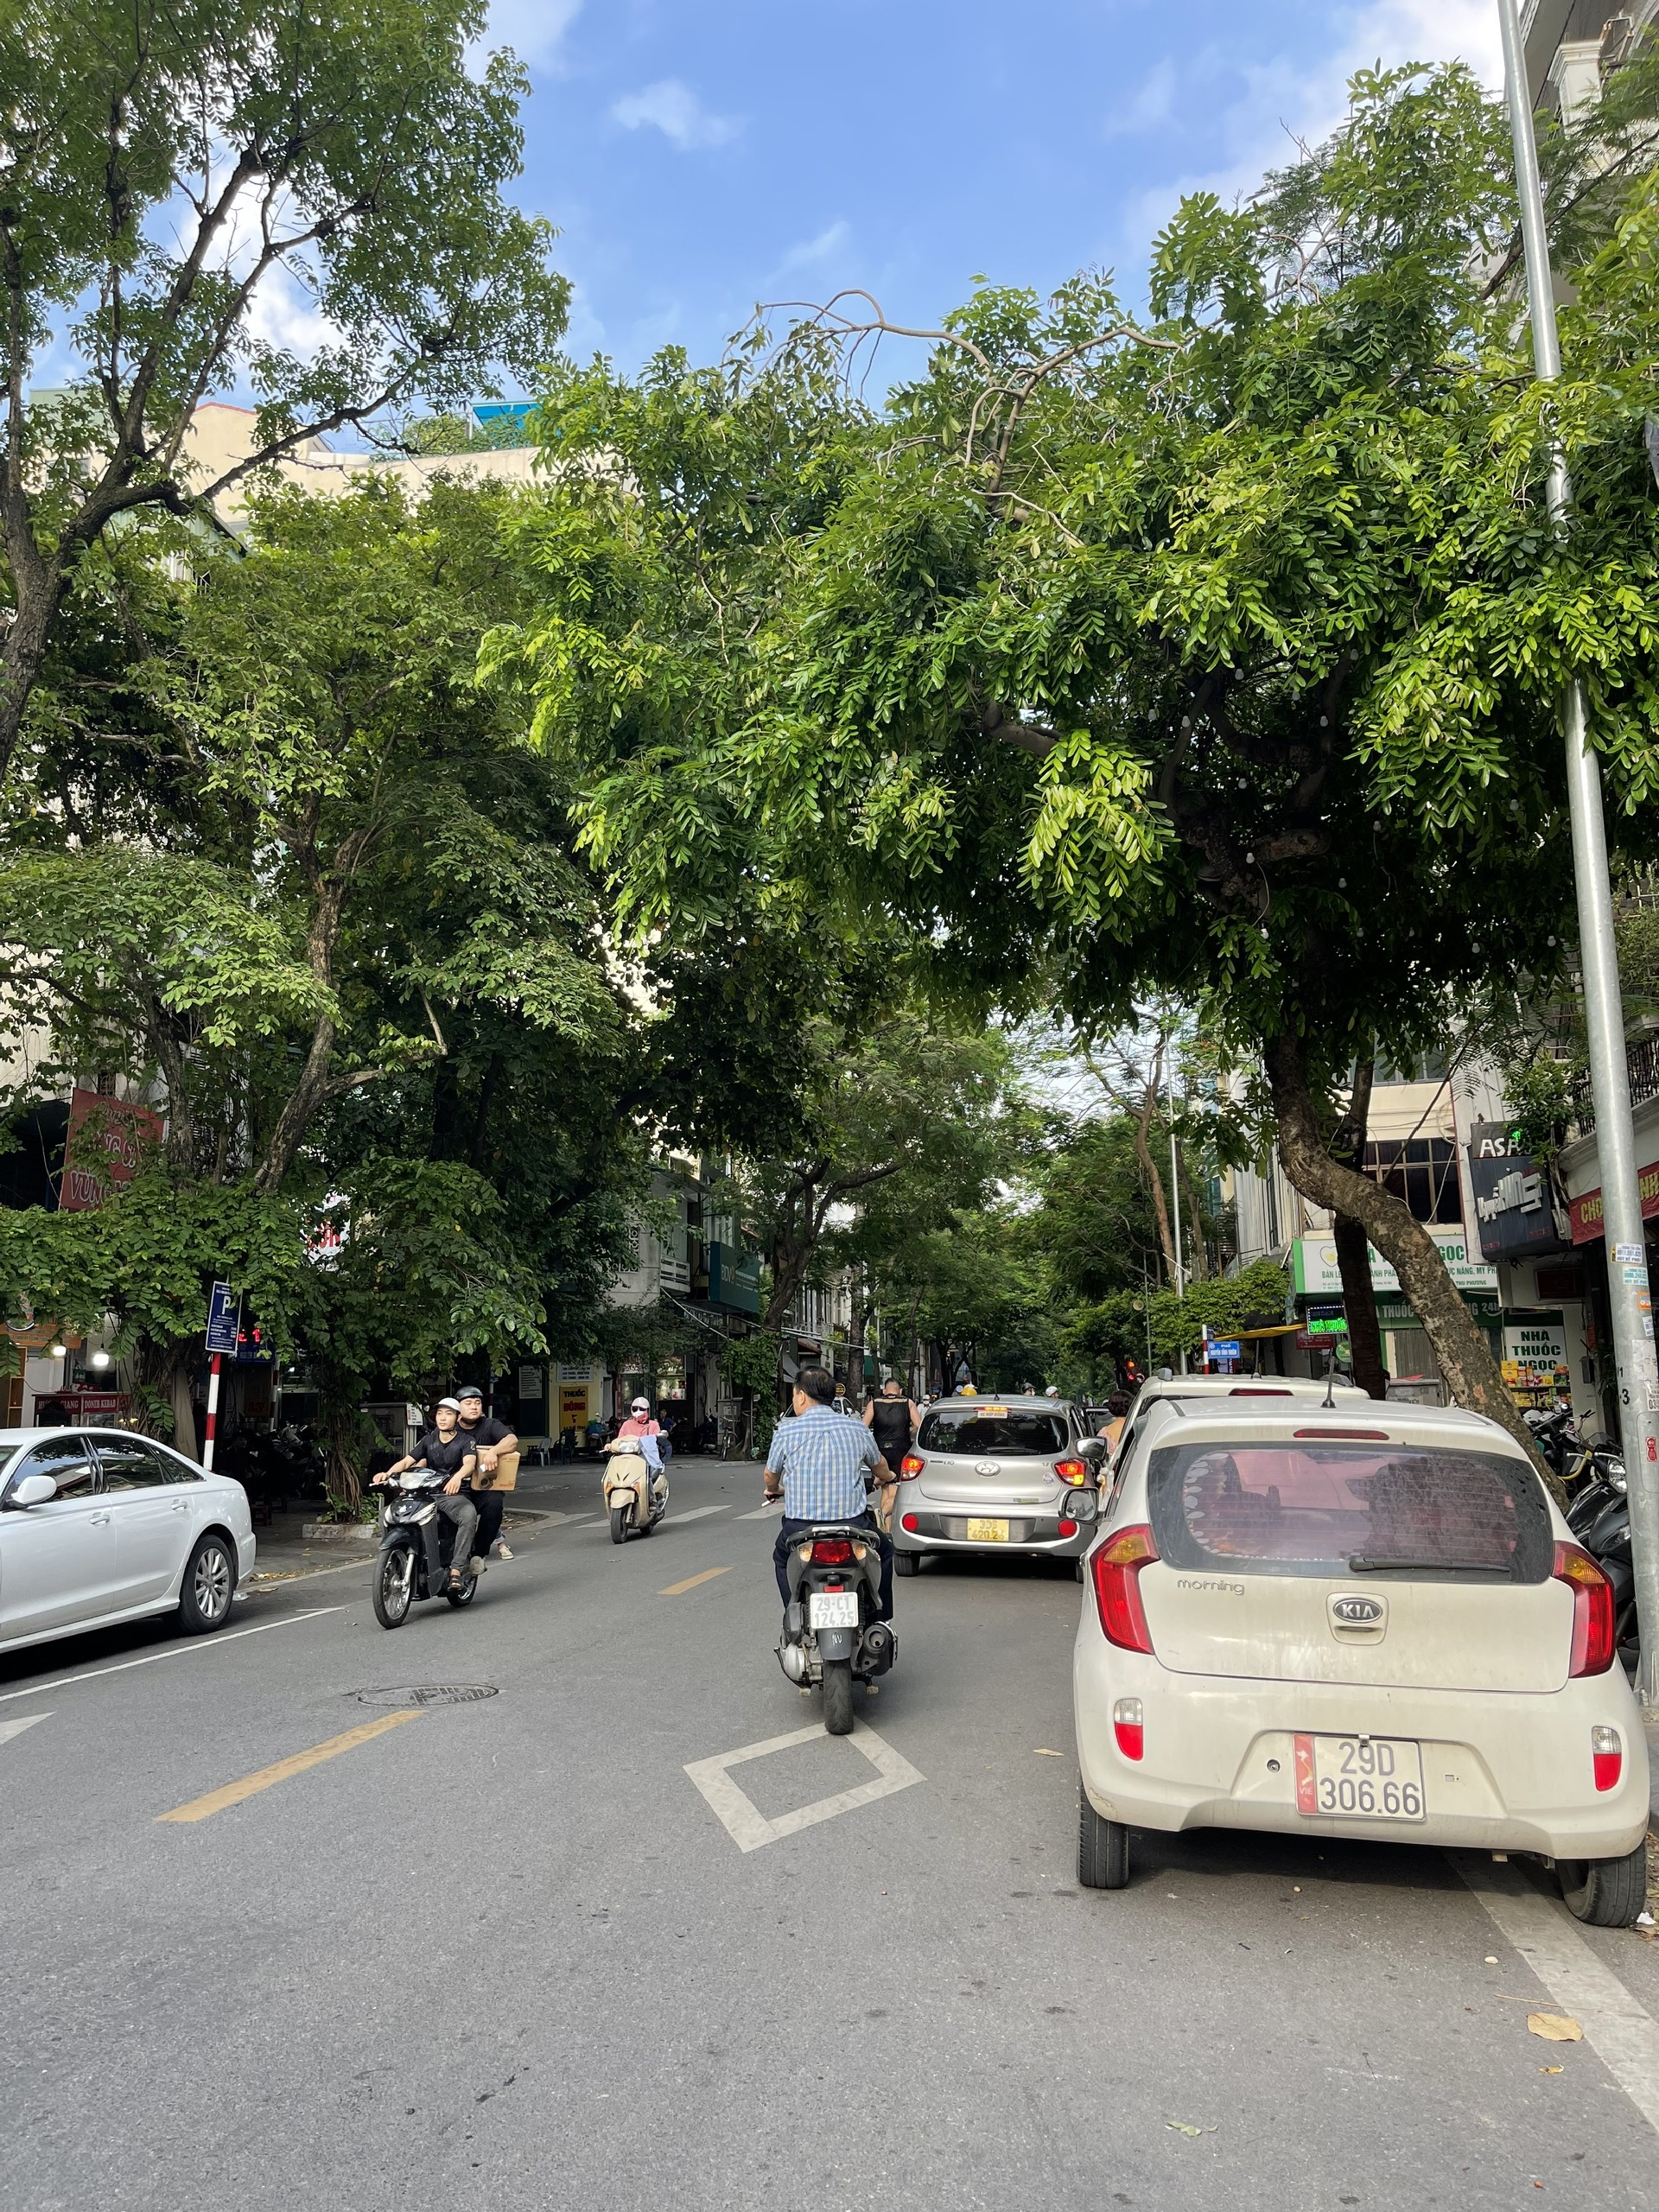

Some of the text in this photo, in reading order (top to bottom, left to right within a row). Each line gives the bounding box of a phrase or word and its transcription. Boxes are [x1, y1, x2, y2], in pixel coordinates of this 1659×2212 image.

[1438, 1245, 1465, 1263] GỌC
[221, 1295, 232, 1315] P
[1521, 1329, 1550, 1341] NHÀ
[1512, 1342, 1560, 1356] THUỐC
[1518, 1360, 1557, 1372] NGỌC
[1177, 1578, 1245, 1596] morning
[817, 1595, 849, 1611] 29-C1
[1341, 1603, 1376, 1618] KIA
[814, 1611, 855, 1627] 124.25
[1338, 1741, 1395, 1777] 29D
[1299, 1787, 1313, 1796] VIE
[1319, 1777, 1421, 1815] 306.66
